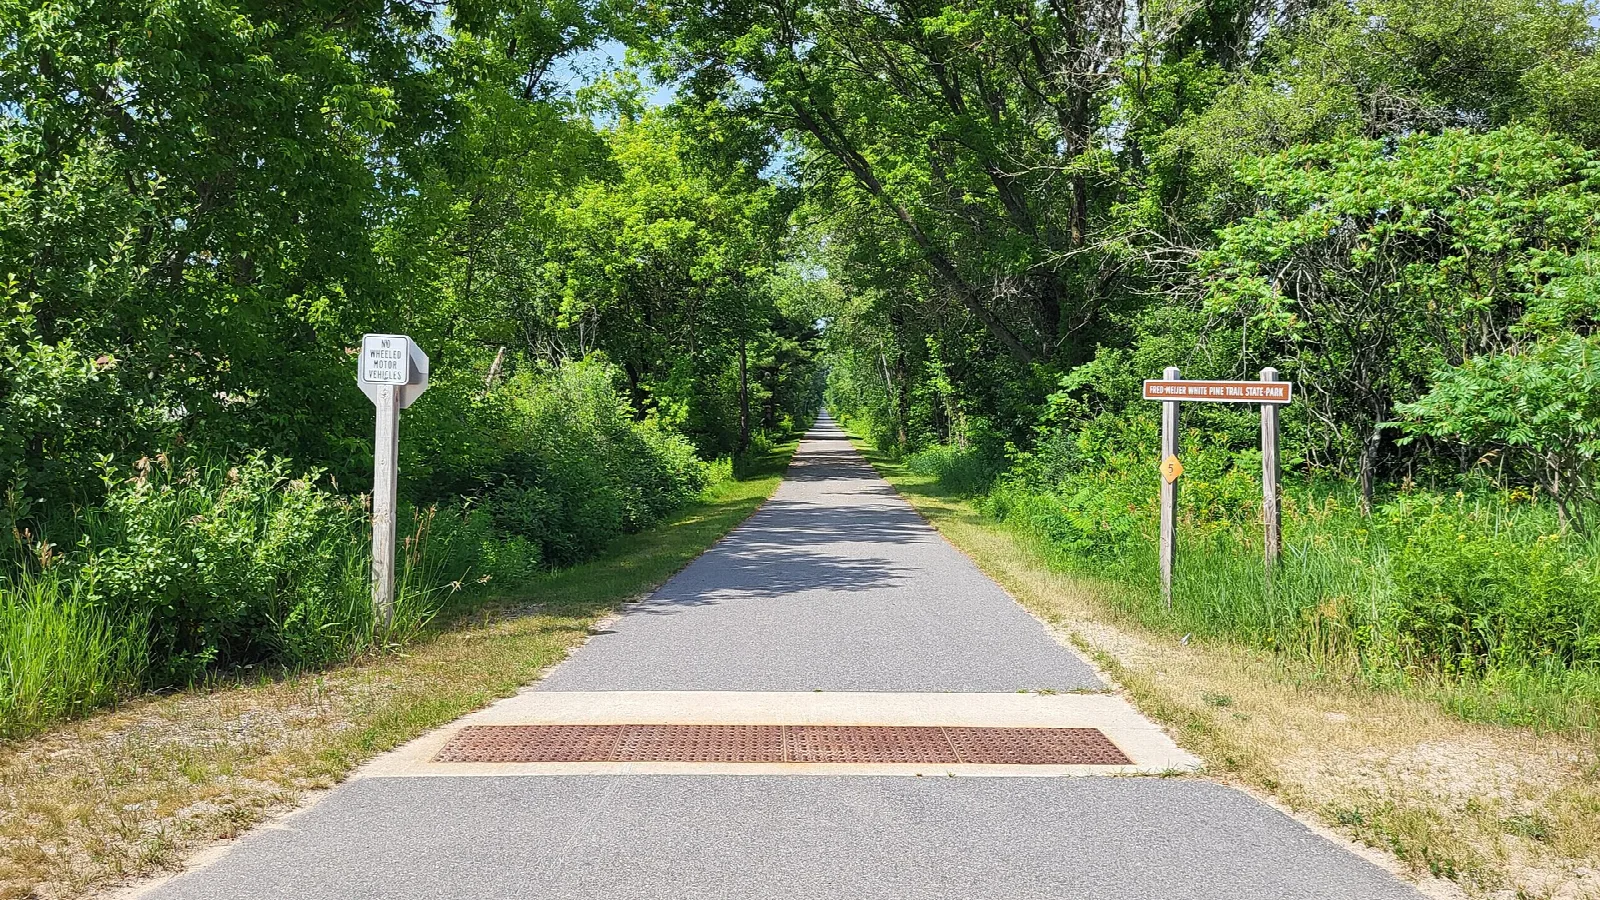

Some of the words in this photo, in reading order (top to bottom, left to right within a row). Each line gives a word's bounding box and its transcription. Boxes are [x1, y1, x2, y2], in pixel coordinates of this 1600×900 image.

[381, 339, 391, 348] NO
[370, 350, 402, 359] WHEELED
[373, 360, 397, 369] MOTOR
[369, 370, 402, 380] VEHICLES
[1188, 386, 1207, 395] WHITE
[1209, 386, 1224, 396] PINE
[1226, 386, 1244, 396] TRAIL
[1245, 386, 1263, 397] STATE
[1265, 387, 1283, 397] PARK
[1168, 463, 1174, 473] 5
